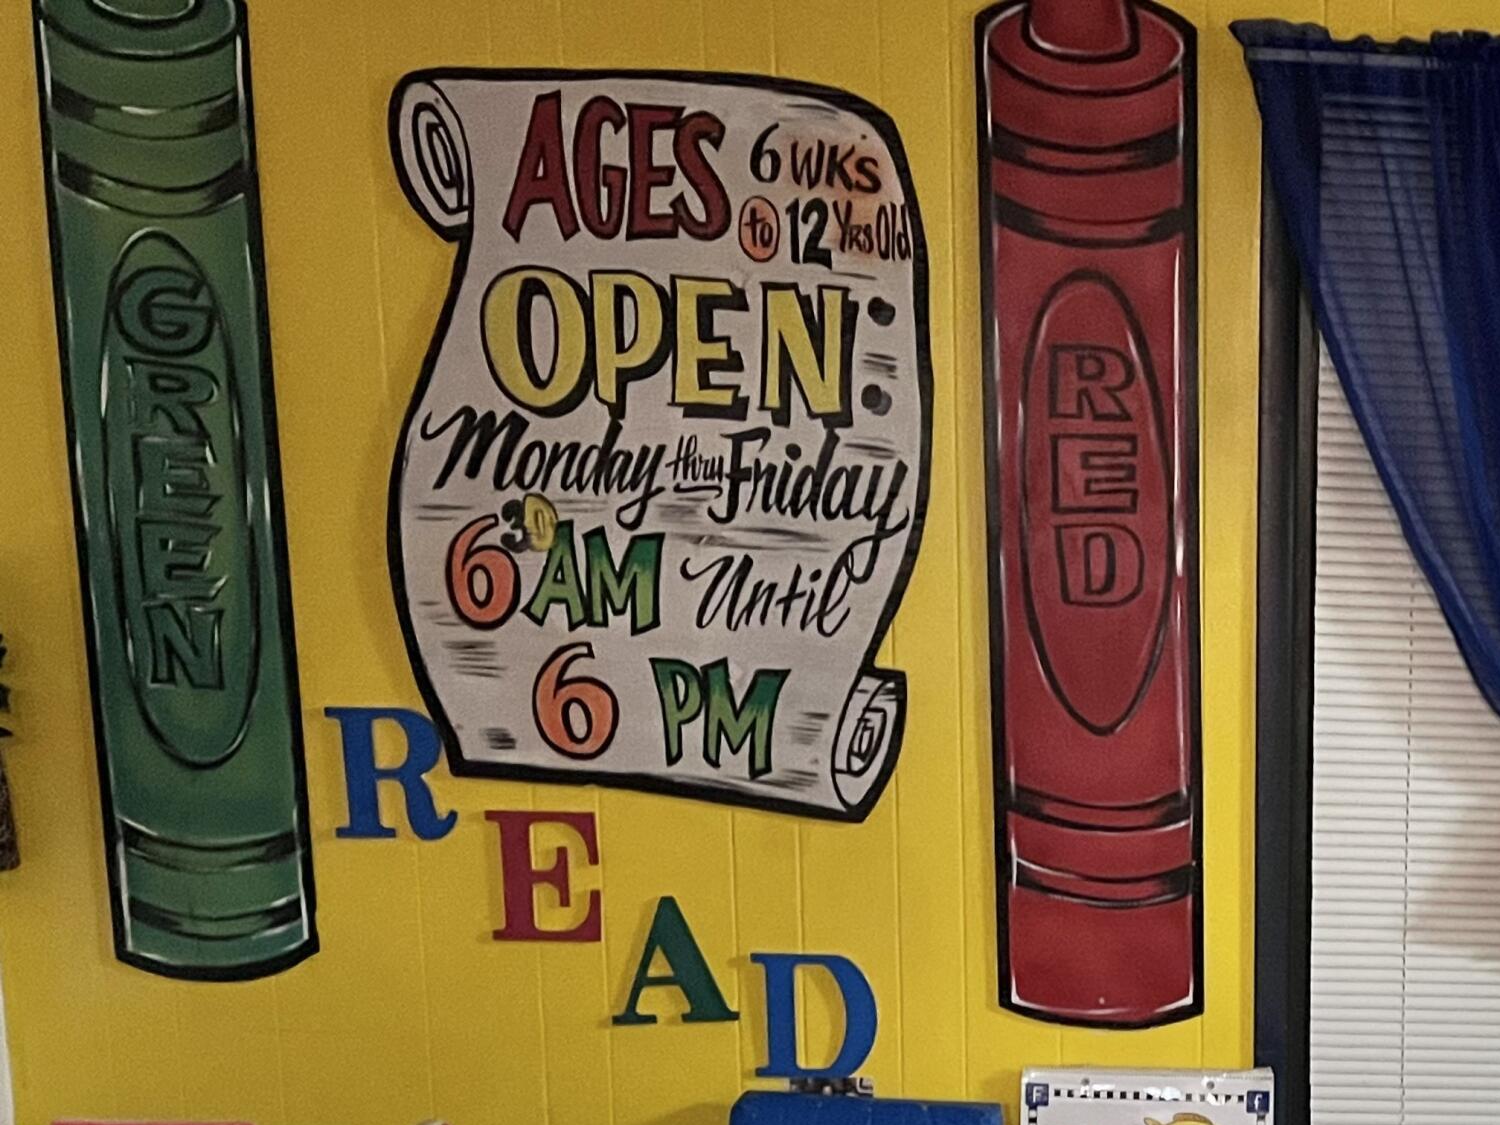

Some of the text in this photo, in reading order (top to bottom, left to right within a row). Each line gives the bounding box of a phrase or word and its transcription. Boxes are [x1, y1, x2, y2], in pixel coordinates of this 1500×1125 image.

[502, 90, 732, 243] AGES
[750, 122, 782, 184] 6
[745, 206, 774, 249] to
[785, 197, 833, 270] 12
[113, 264, 228, 692] GREEN
[420, 403, 910, 583] Monday thru Friday
[1045, 342, 1146, 610] RED
[445, 513, 521, 631] 6
[522, 527, 662, 636] AM
[679, 550, 854, 637] Until
[532, 642, 792, 778] 6 PM
[323, 705, 881, 1080] READ
